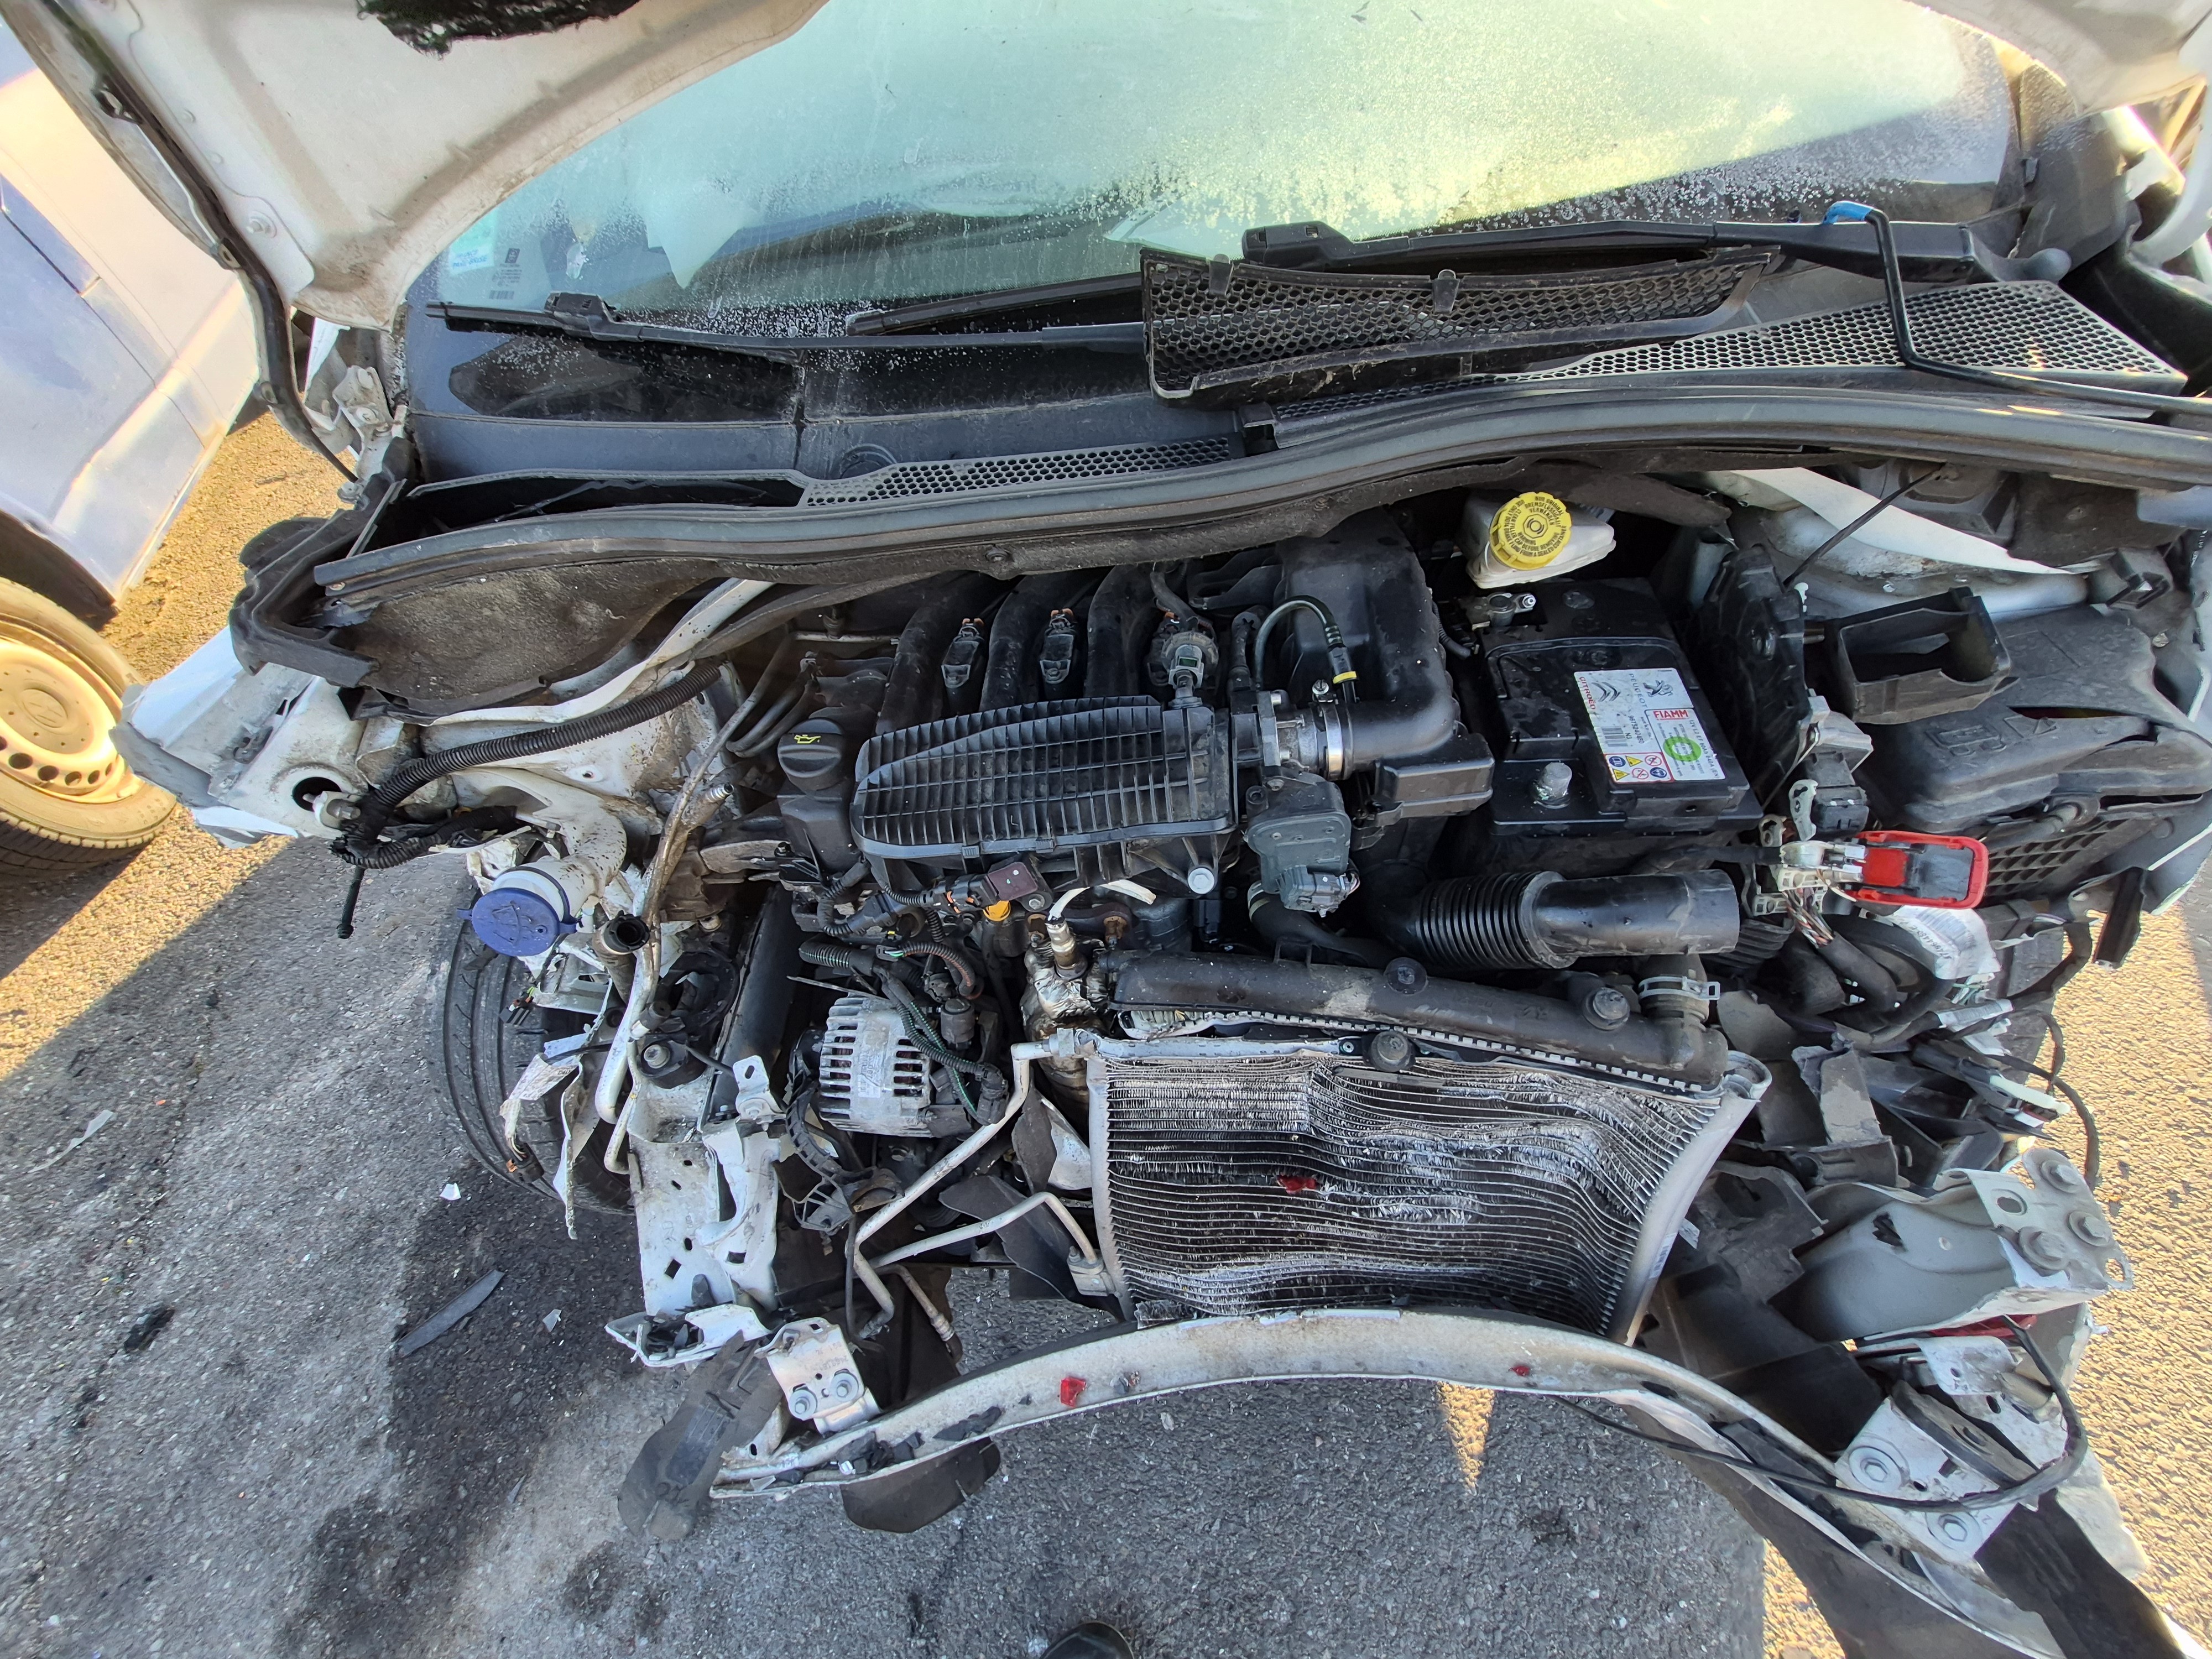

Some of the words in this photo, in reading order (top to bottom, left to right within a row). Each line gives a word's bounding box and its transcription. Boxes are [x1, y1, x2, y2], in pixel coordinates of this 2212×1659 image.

[1546, 499, 1564, 516] ORIGINAL
[1529, 508, 1554, 525] VERWENDEN
[1540, 532, 1559, 550] REMOVING
[1553, 525, 1567, 549] CONTAINER
[1629, 673, 1648, 708] PEUGEOT
[1653, 710, 1689, 719] FIAMM
